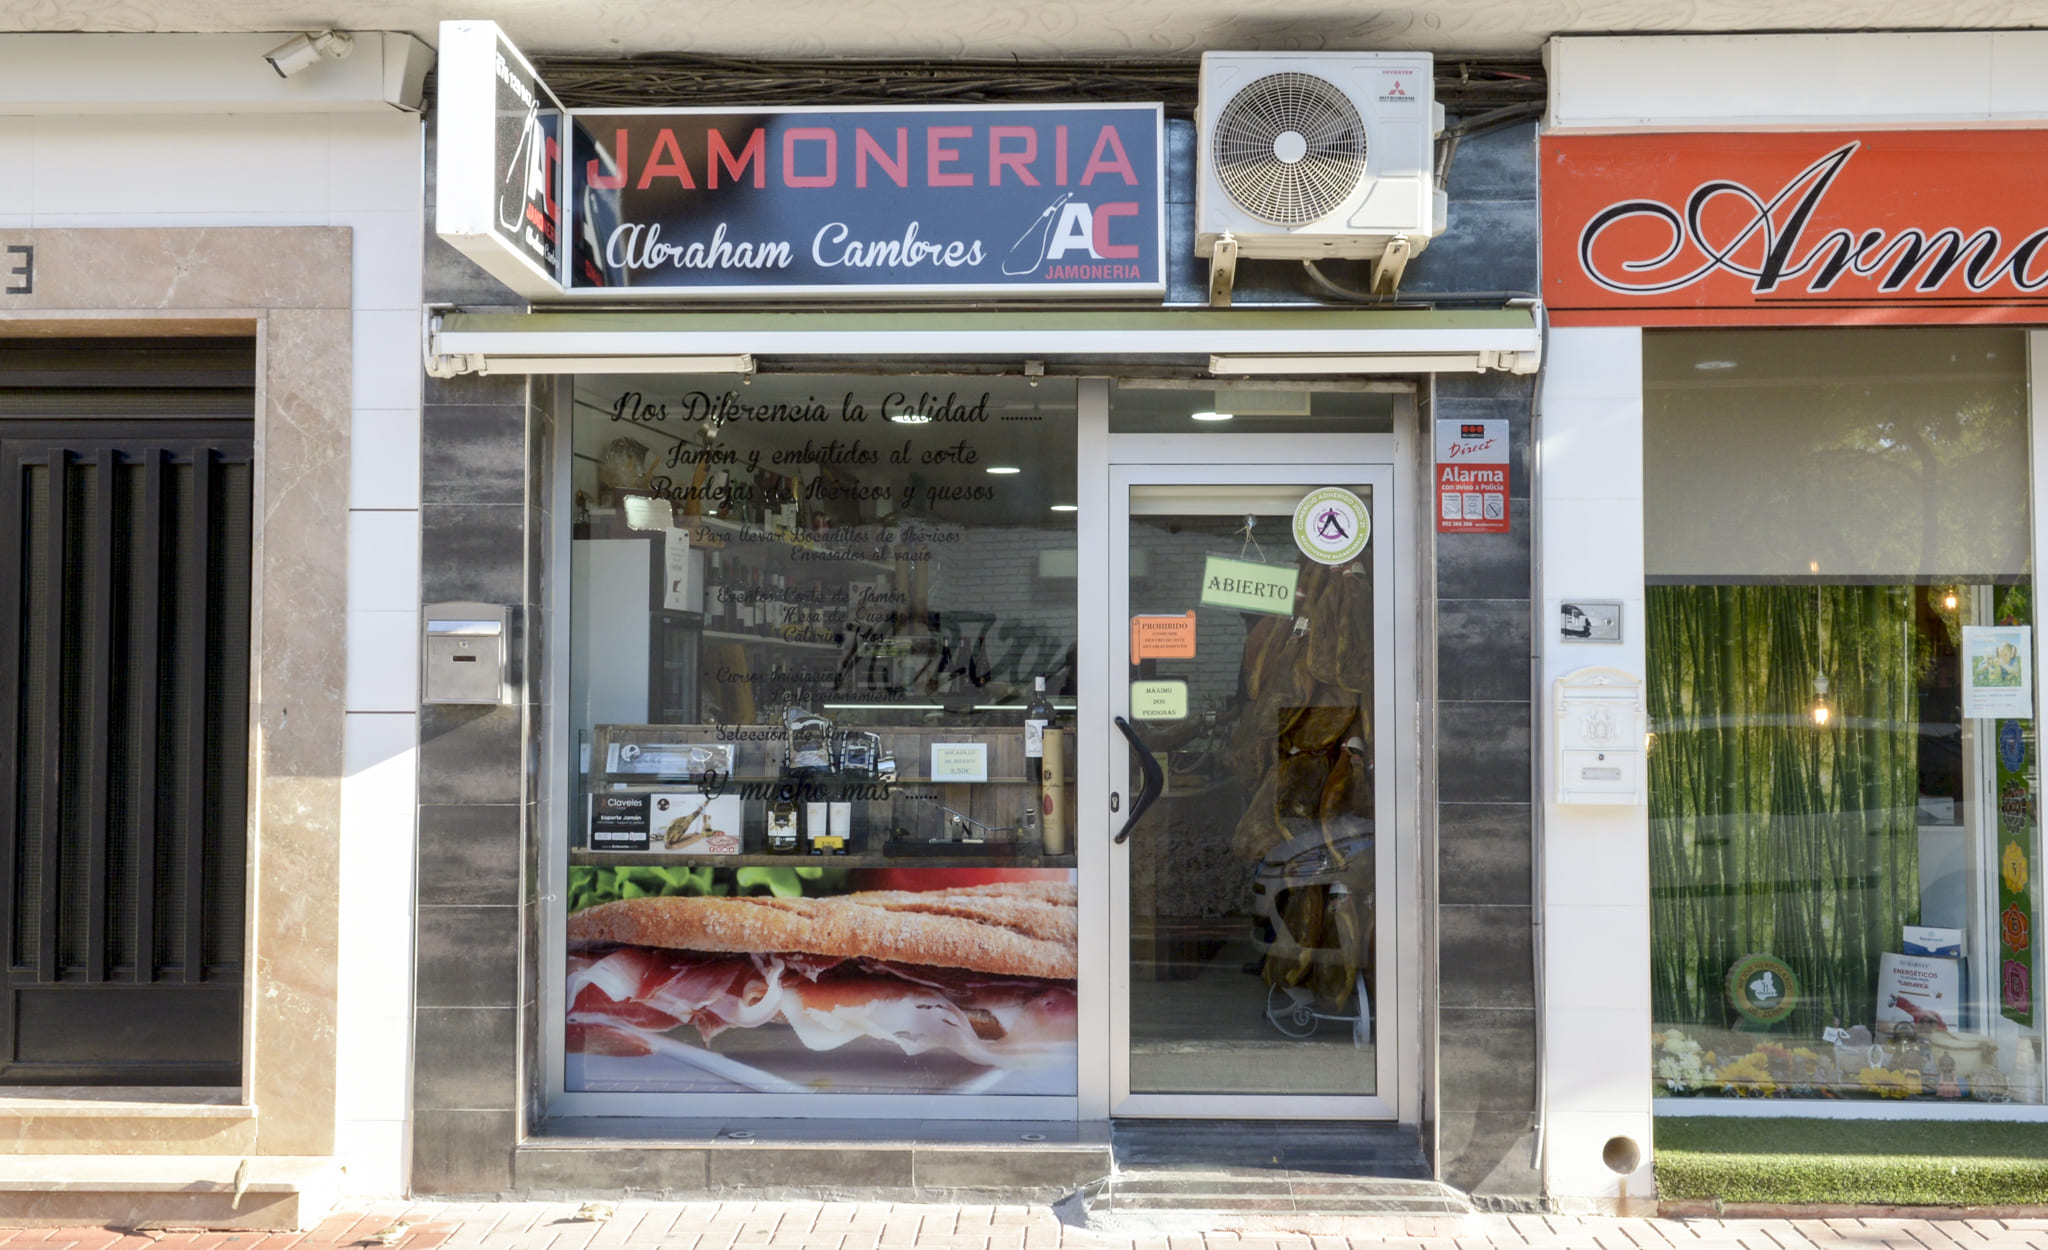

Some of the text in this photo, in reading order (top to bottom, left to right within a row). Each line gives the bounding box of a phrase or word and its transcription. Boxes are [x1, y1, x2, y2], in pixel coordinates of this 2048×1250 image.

[586, 125, 1139, 190] JAMONERIA
[1046, 201, 1139, 259] AC
[606, 222, 987, 270] Abraham Cambres
[6, 245, 34, 294] 3
[1045, 265, 1140, 279] JAMONERIA
[611, 391, 668, 421] Nos
[682, 391, 829, 428] Diferencia
[842, 391, 868, 422] la
[881, 391, 990, 422] Calidad
[667, 439, 979, 472] Jamón y embutidos al corte
[1449, 438, 1497, 458] Direct
[1442, 466, 1504, 482] Alarma
[650, 475, 995, 511] Bandejas de Ibéricos y quesos
[695, 526, 732, 544] Para
[790, 526, 869, 544] Bocadillos
[876, 526, 895, 543] de
[901, 526, 961, 544] Ibéricos
[790, 546, 866, 562] Envasados
[872, 545, 887, 561] al
[1208, 576, 1288, 600] ABIERTO
[829, 605, 850, 623] de
[716, 724, 787, 742] Selección
[703, 768, 730, 800] Y
[740, 768, 829, 801] mucho
[607, 798, 642, 807] Claveles
